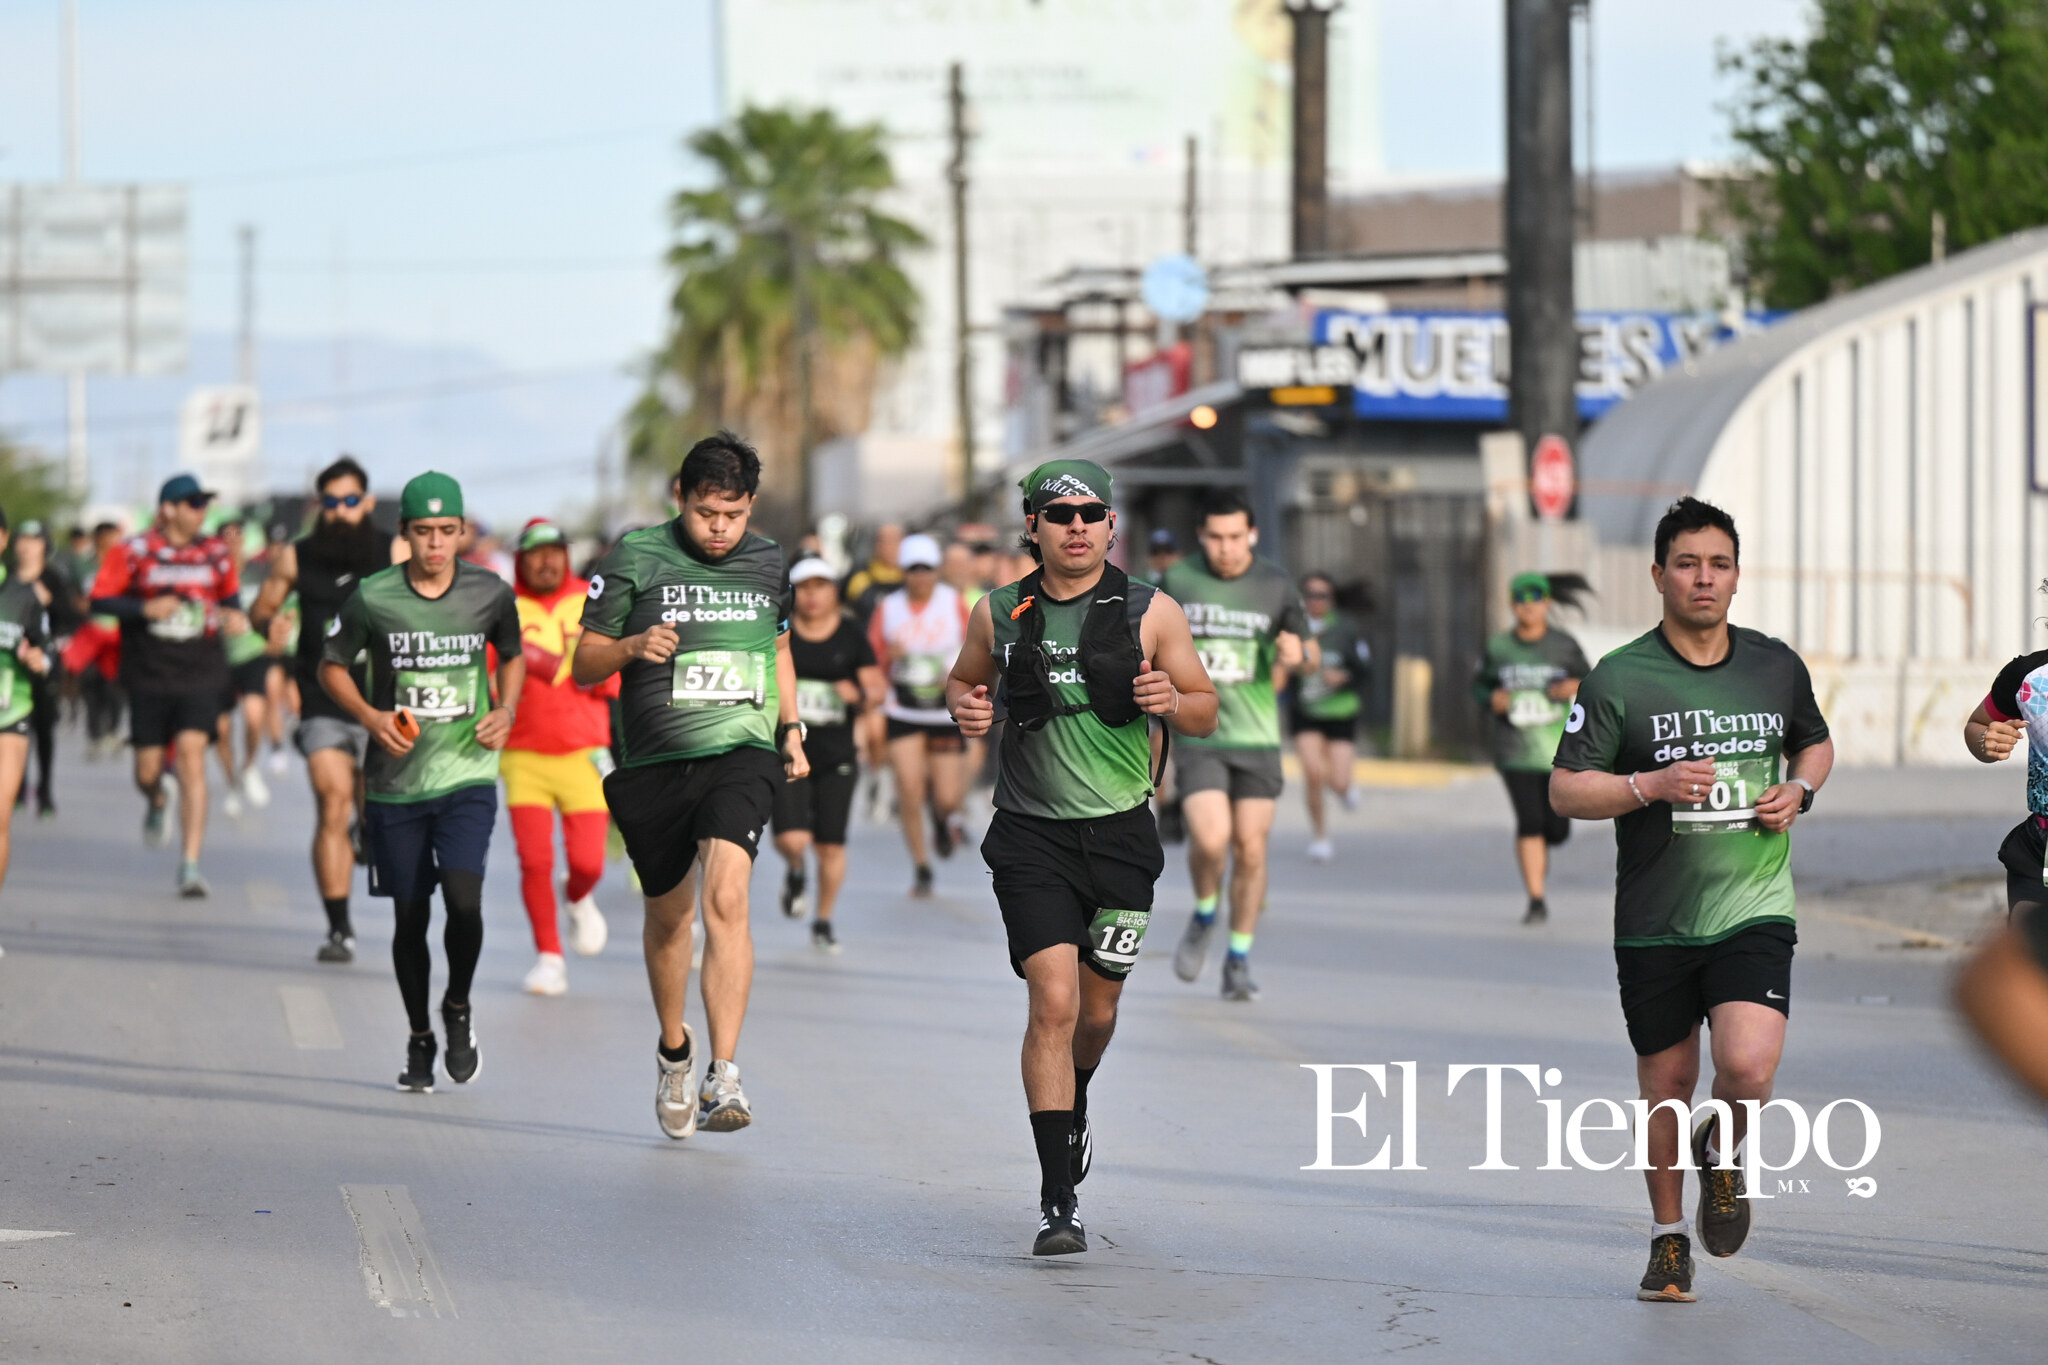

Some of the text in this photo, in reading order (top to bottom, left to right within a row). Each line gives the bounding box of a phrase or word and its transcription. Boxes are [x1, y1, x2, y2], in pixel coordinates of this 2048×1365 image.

[1061, 473, 1100, 499] odos
[661, 585, 770, 608] El Tiempo
[661, 607, 758, 622] de todos
[388, 630, 486, 653] El Tiempo
[392, 653, 471, 668] de todos
[685, 665, 743, 690] 576
[406, 686, 458, 709] 132
[1650, 709, 1784, 742] El Tiempo
[1654, 737, 1767, 762] de todos
[1693, 780, 1748, 811] 01
